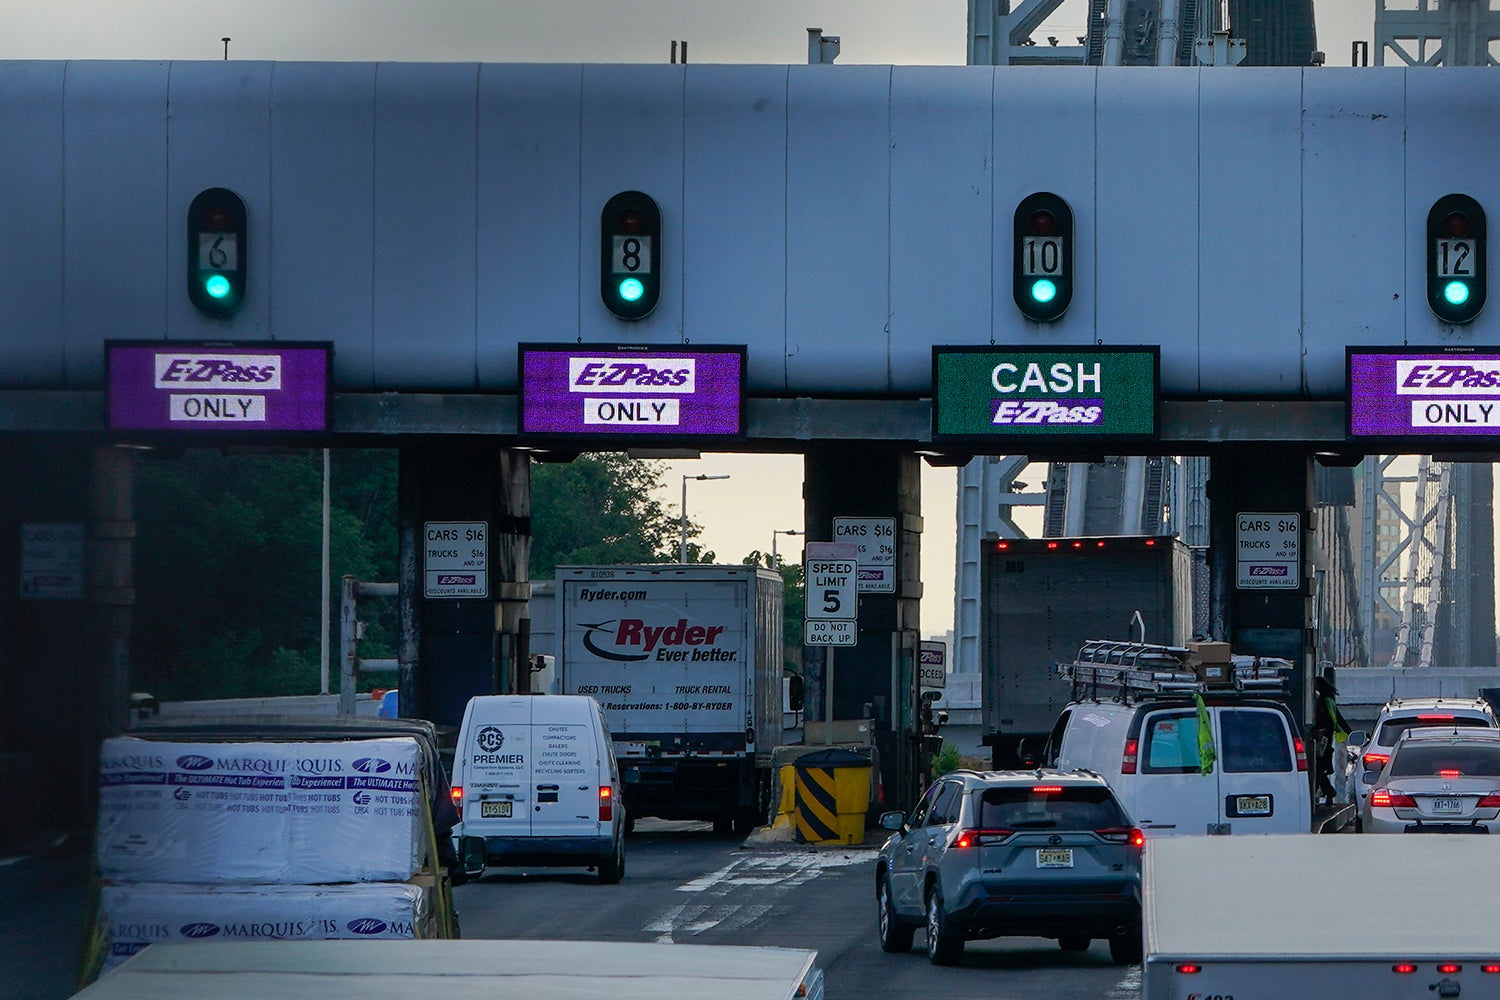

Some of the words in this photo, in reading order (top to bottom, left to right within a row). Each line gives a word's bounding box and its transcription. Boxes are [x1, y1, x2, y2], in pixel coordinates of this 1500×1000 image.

[209, 236, 227, 268] 6
[622, 238, 641, 271] 8
[1027, 240, 1058, 273] 10
[1440, 241, 1470, 275] 12
[991, 362, 1101, 393] CASH
[184, 398, 253, 417] ONLY
[597, 402, 666, 421] ONLY
[1425, 403, 1494, 423] ONLY
[837, 525, 867, 536] CARS
[874, 524, 893, 537] $16
[1240, 521, 1270, 532] CARS
[1278, 519, 1296, 533] $16
[428, 530, 458, 541] CARS
[466, 529, 484, 542] $16
[879, 544, 893, 554] $16
[1240, 540, 1270, 549] TRUCKS
[1283, 540, 1296, 549] $16
[428, 550, 458, 558] TRUCKS
[471, 549, 485, 558] $16
[813, 564, 852, 574] SPEED
[816, 577, 848, 587] LIMIT
[580, 588, 647, 602] Ryder.com
[823, 590, 841, 613] 5
[615, 618, 724, 652] Ryder
[811, 634, 834, 642] BACK
[839, 634, 851, 642] UP
[656, 648, 690, 662] Ever
[692, 648, 737, 662] better.
[577, 685, 599, 694] USED
[601, 685, 632, 694] TRUCKS
[675, 685, 701, 694] TRUCK
[702, 685, 732, 694] RENTAL
[607, 702, 663, 710] Reservations:
[665, 702, 733, 710] 1-800-BY-RYDER
[480, 733, 503, 746] PCS
[473, 754, 524, 764] PREMIER
[189, 776, 225, 784] ULTIMATE
[301, 777, 342, 788] Experience!
[353, 778, 366, 786] The
[367, 779, 402, 789] ULTIMATE
[308, 794, 322, 802] HOT
[323, 794, 341, 802] TUBS
[374, 795, 388, 803] HOT
[390, 796, 408, 805] TUBS
